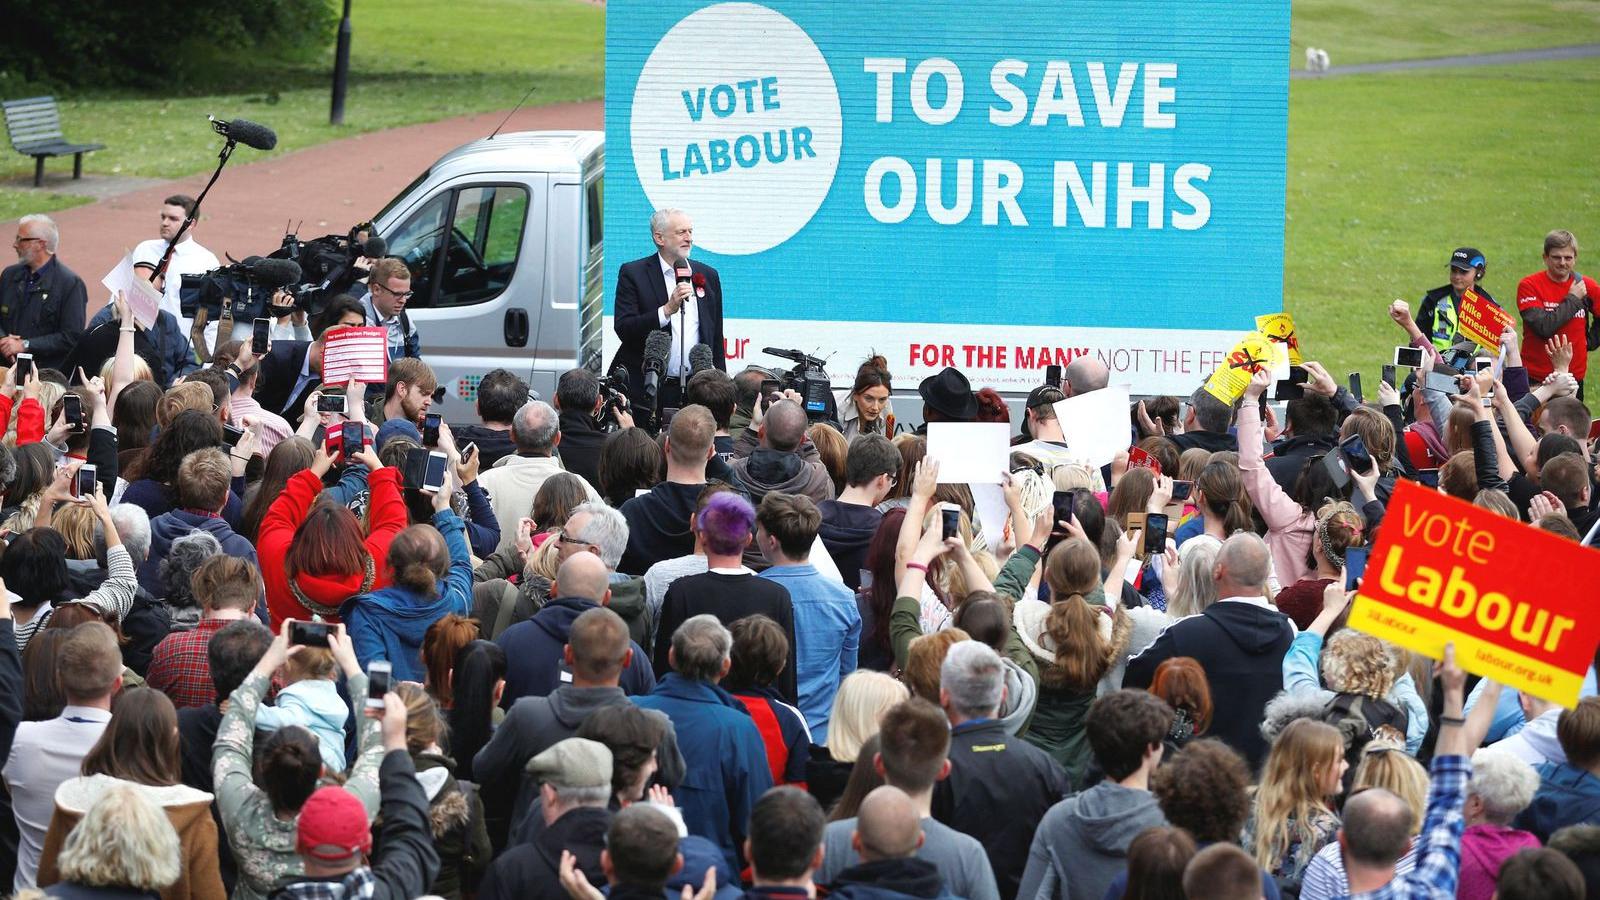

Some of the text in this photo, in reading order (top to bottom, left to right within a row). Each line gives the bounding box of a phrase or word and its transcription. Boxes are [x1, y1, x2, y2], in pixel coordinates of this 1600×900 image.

[681, 76, 781, 122] VOTE
[863, 57, 1178, 130] TO SAVE
[659, 126, 817, 182] LABOUR
[863, 155, 1212, 231] OUR NHS
[1459, 310, 1500, 343] Amesbur
[1461, 299, 1482, 320] Mike
[909, 344, 957, 367] FOR
[962, 345, 1007, 369] THE
[1097, 348, 1144, 372] NOT
[1149, 350, 1192, 373] THE
[1200, 351, 1228, 374] FE
[1402, 503, 1496, 565] vote
[1379, 544, 1576, 653] Labour
[1474, 648, 1554, 687] labour.org.uk
